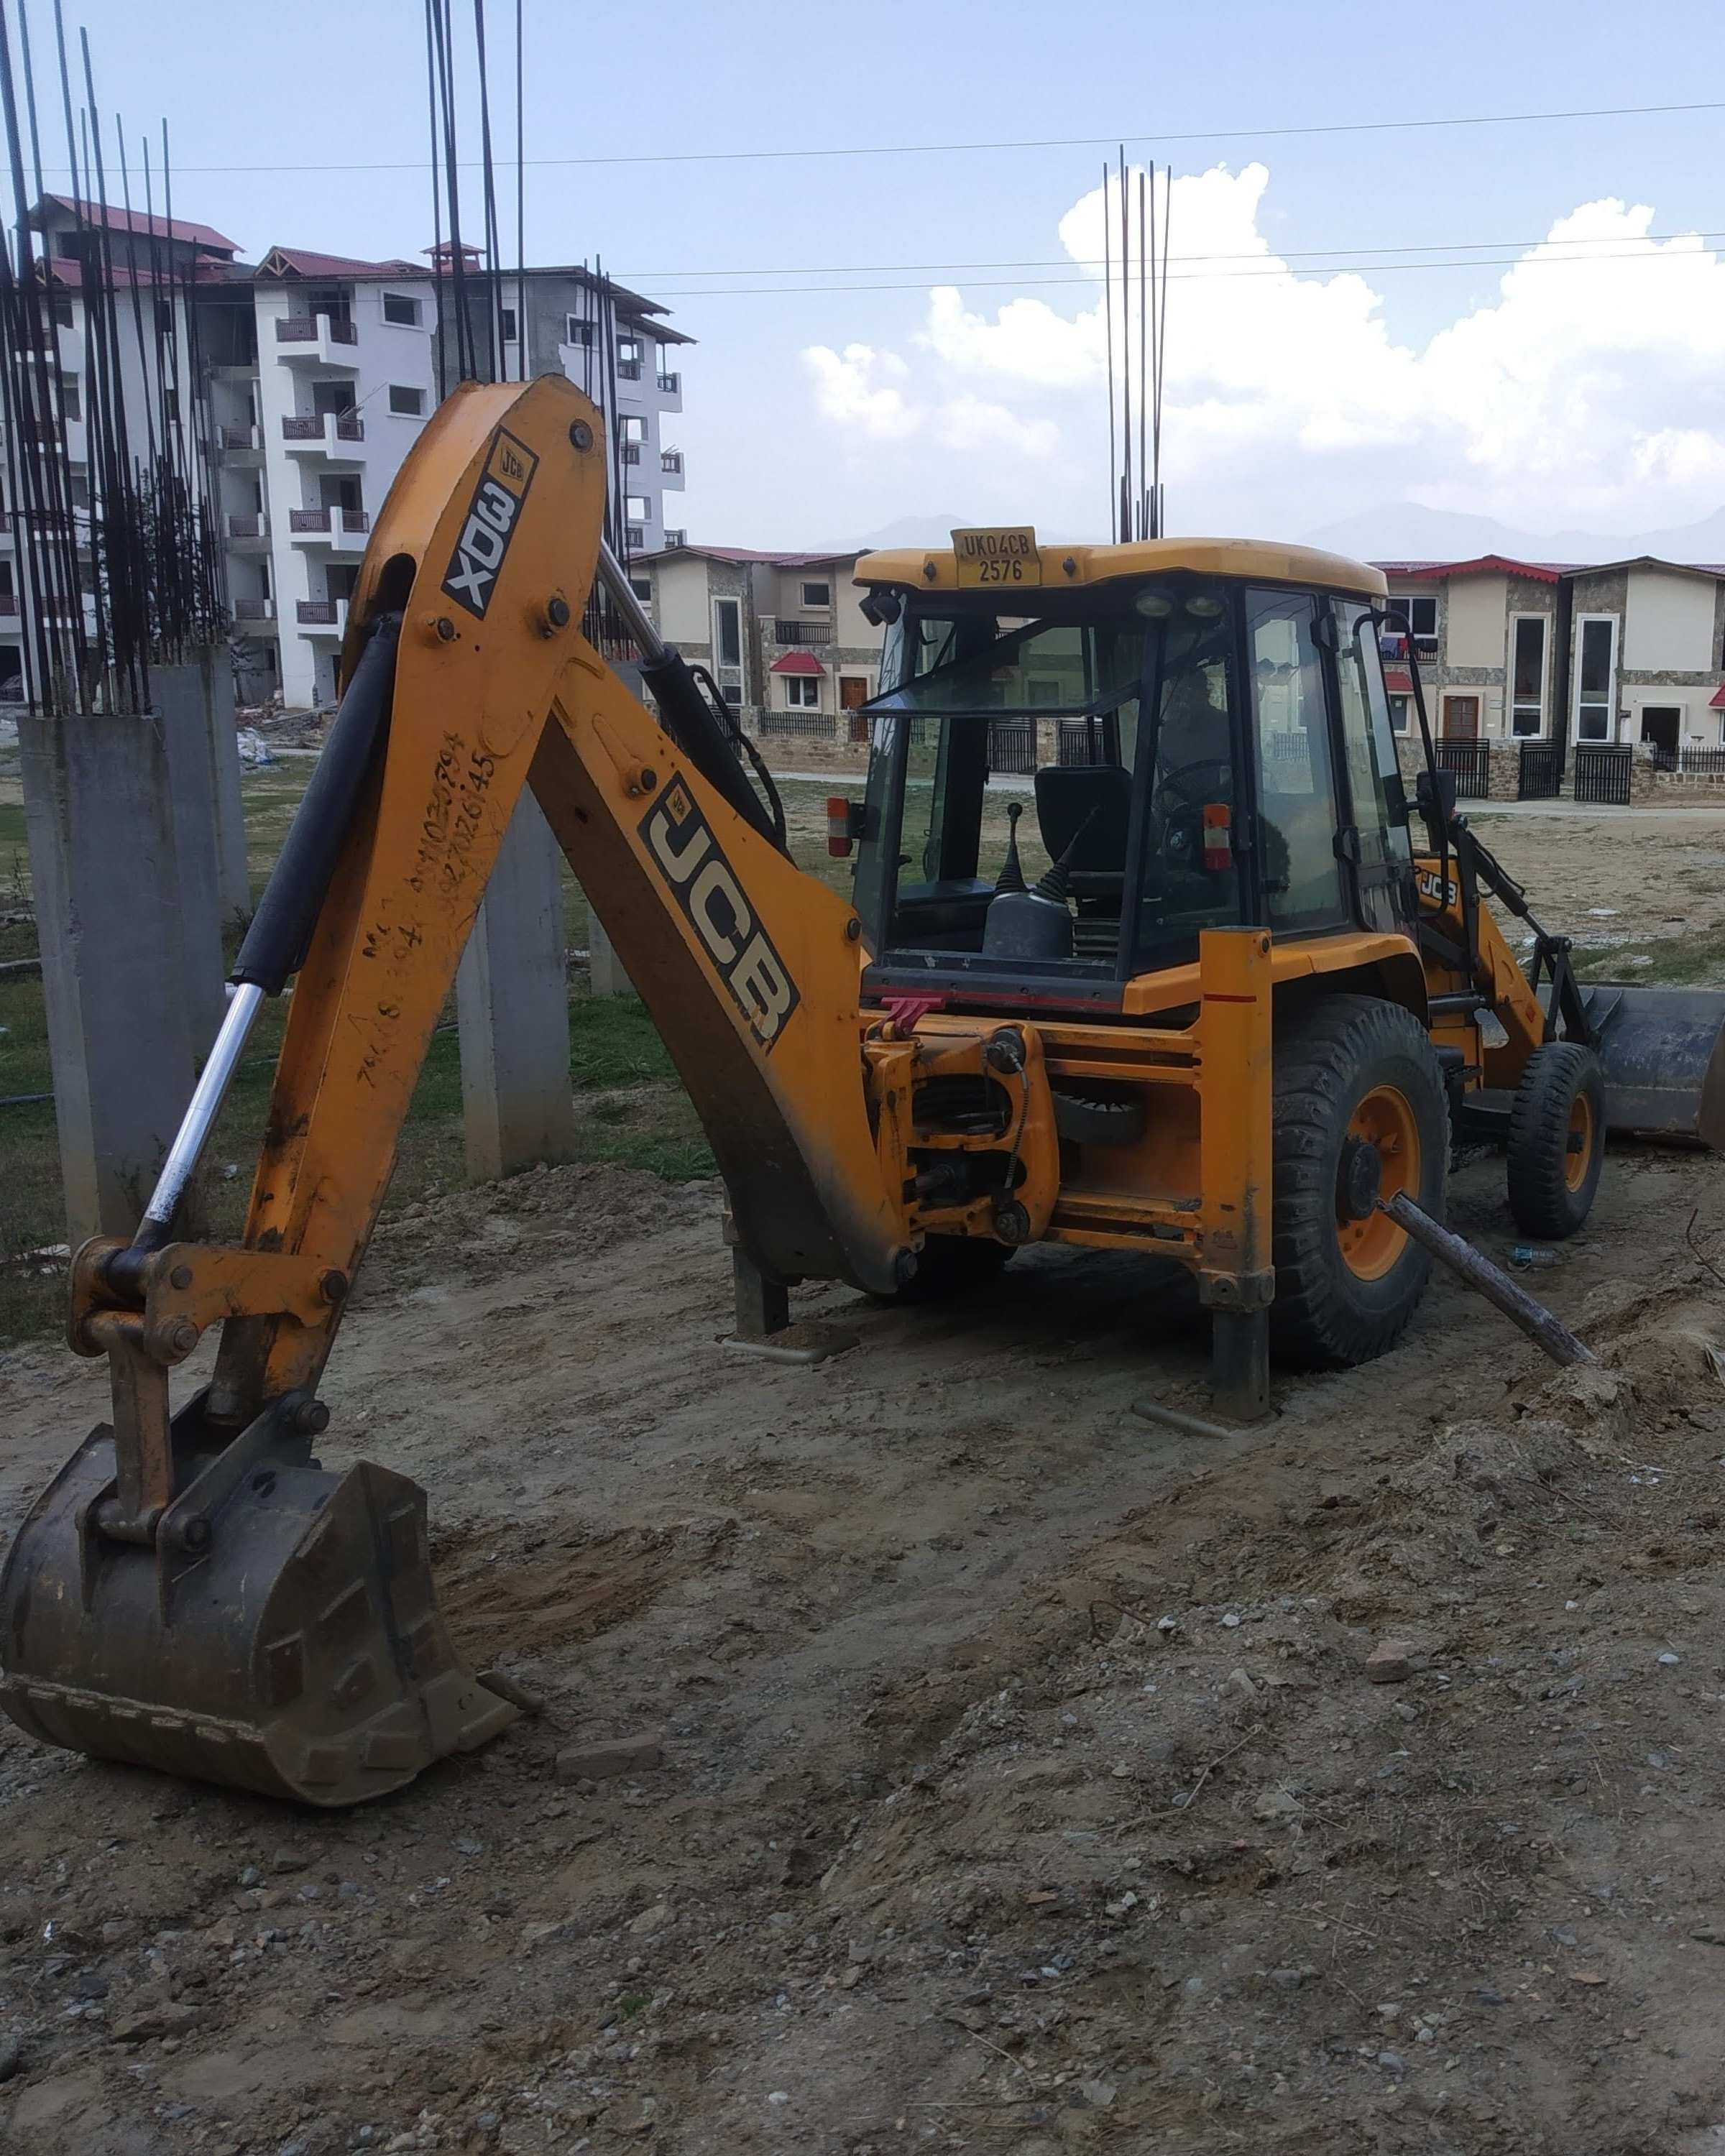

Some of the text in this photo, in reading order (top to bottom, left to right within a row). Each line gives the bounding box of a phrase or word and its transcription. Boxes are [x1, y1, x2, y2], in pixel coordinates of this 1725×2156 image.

[502, 449, 523, 479] JCB
[965, 534, 1029, 556] UK04CB
[980, 560, 1022, 581] 2576
[650, 810, 791, 1039] JCB
